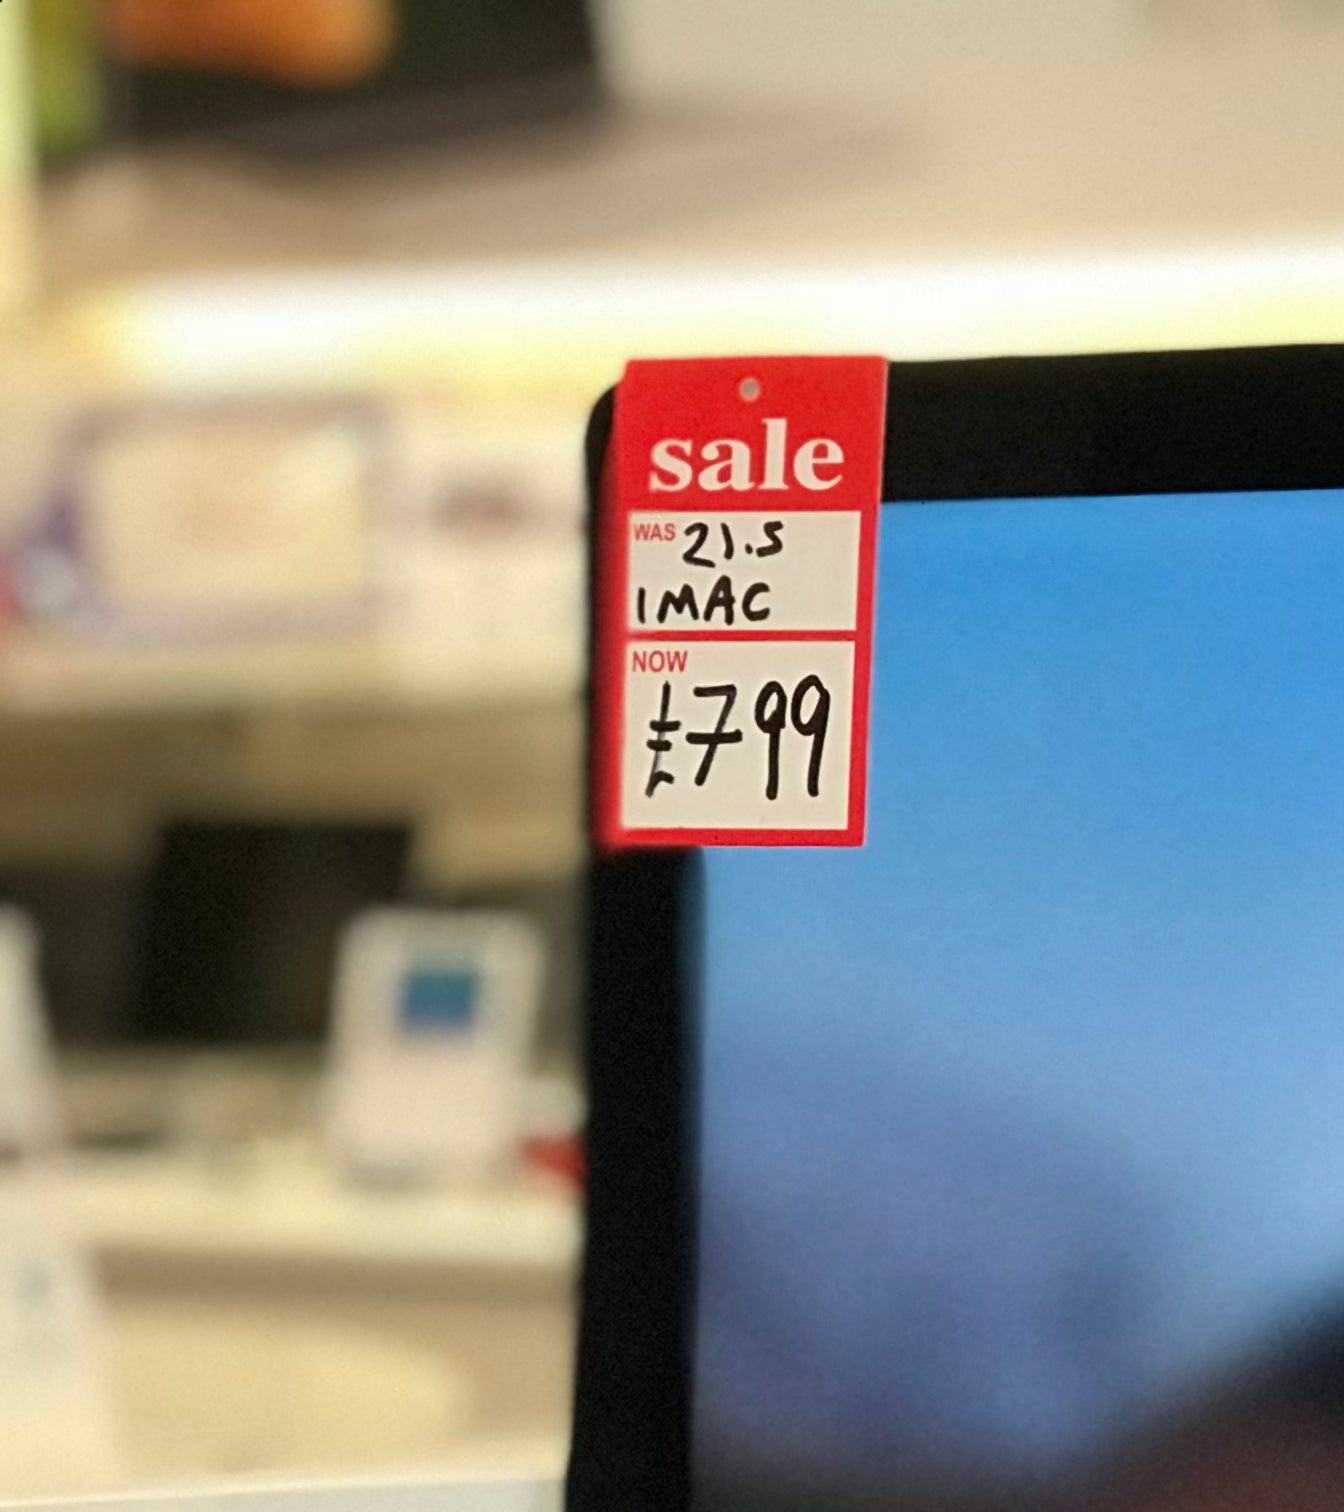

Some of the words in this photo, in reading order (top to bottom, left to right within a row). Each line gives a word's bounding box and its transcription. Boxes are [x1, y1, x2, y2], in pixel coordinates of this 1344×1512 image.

[648, 417, 845, 493] sale
[633, 522, 677, 542] WAS
[682, 520, 785, 568] 21.5
[631, 650, 689, 674] NOW
[645, 674, 831, 801] £799
